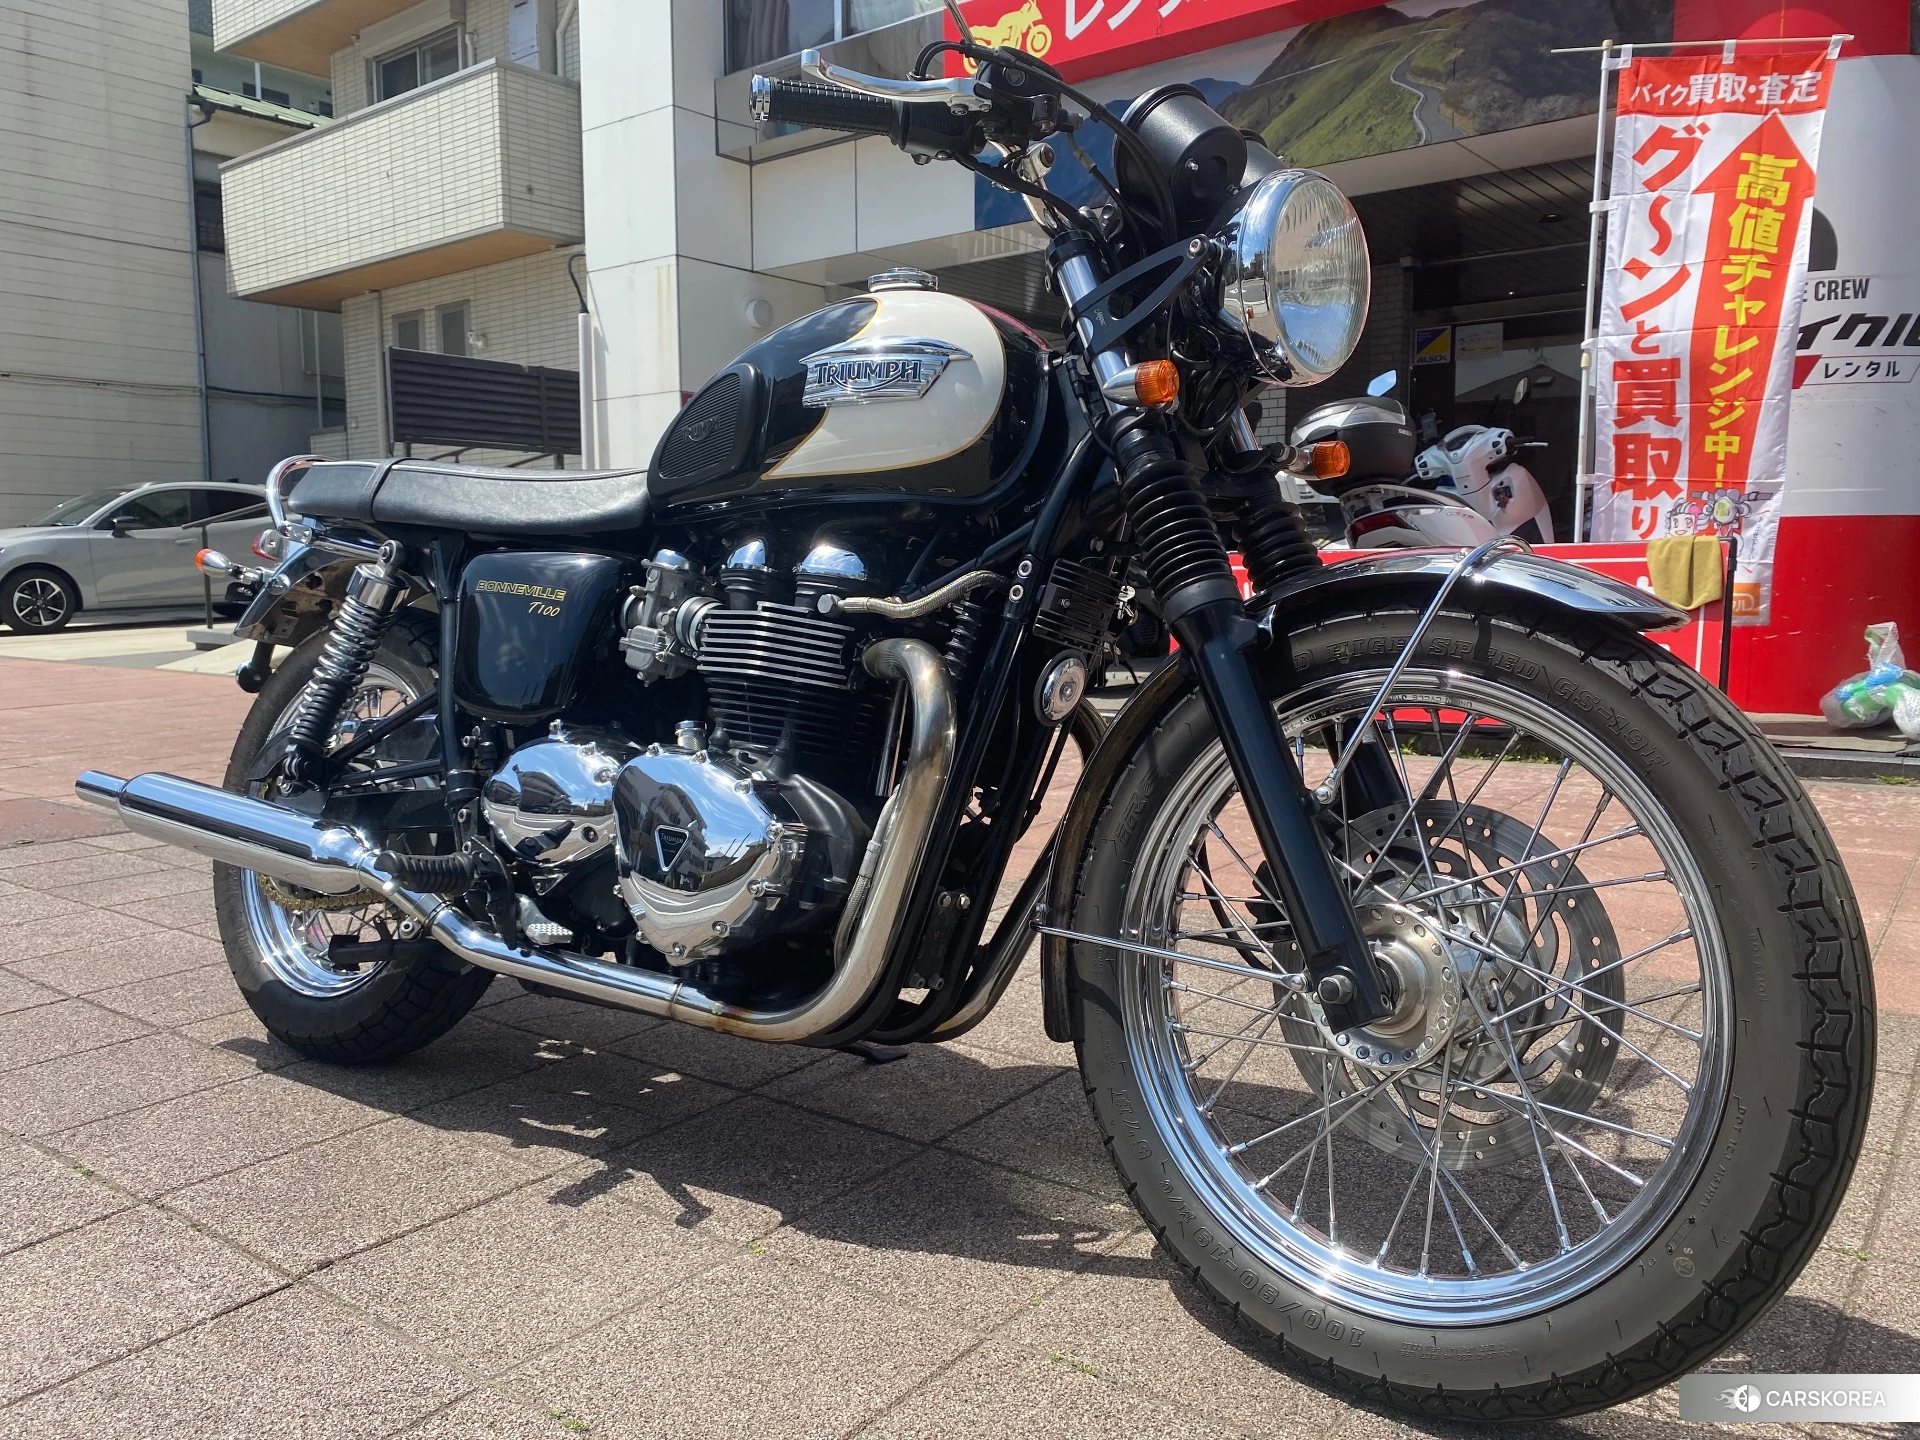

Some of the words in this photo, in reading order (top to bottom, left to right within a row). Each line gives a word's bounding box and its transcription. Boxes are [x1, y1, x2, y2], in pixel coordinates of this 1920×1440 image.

[1630, 70, 1822, 106] バイク買取・査定
[1814, 278, 1870, 302] CREW
[1417, 354, 1448, 363] ALSOK
[1823, 360, 1901, 379] レンタル
[814, 359, 923, 390] TRIUMPH
[476, 579, 567, 601] BONNEVILLE
[528, 601, 561, 617] T100
[1193, 1226, 1365, 1347] 100/90-19
